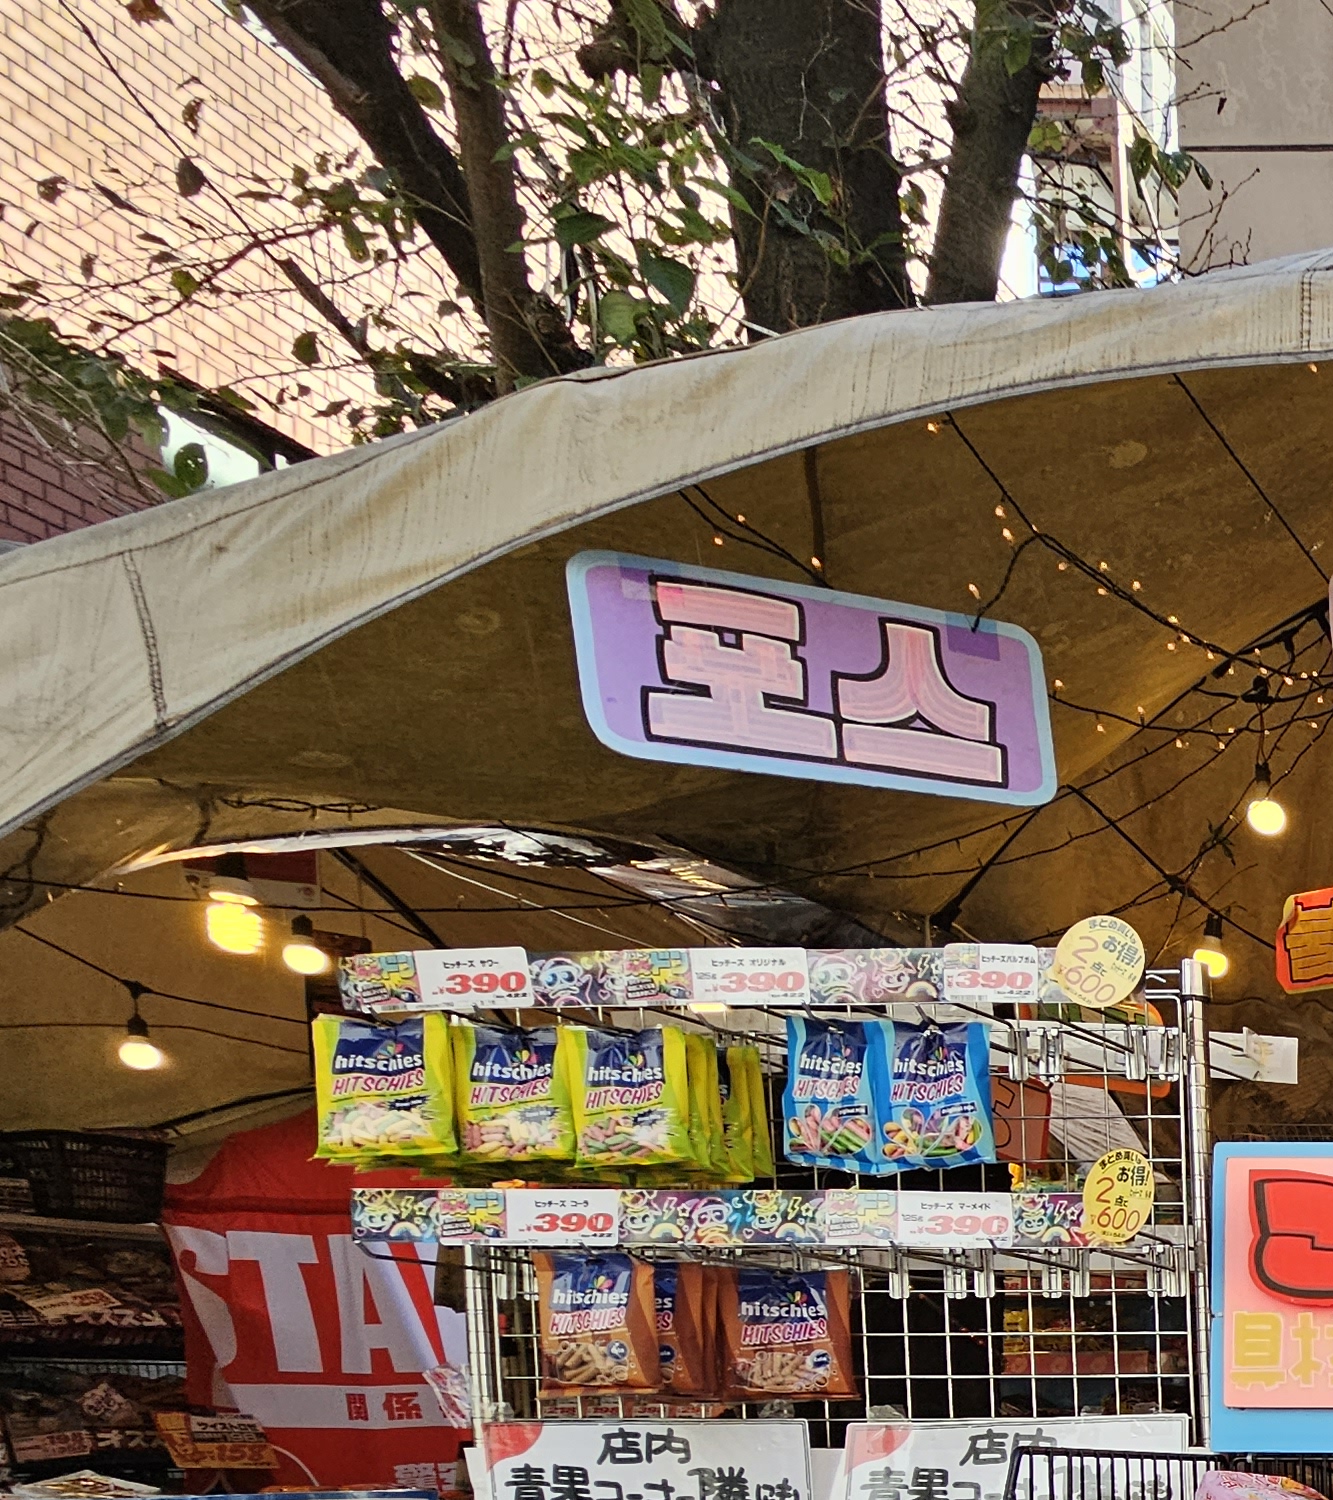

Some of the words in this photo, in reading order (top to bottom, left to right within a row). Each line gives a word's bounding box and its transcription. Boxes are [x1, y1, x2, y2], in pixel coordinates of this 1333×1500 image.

[446, 972, 526, 994] 390
[718, 971, 805, 992] 390
[956, 971, 1033, 989] 390
[532, 1213, 614, 1233] 390
[168, 1225, 445, 1374] STA
[598, 1428, 691, 1466] 店内
